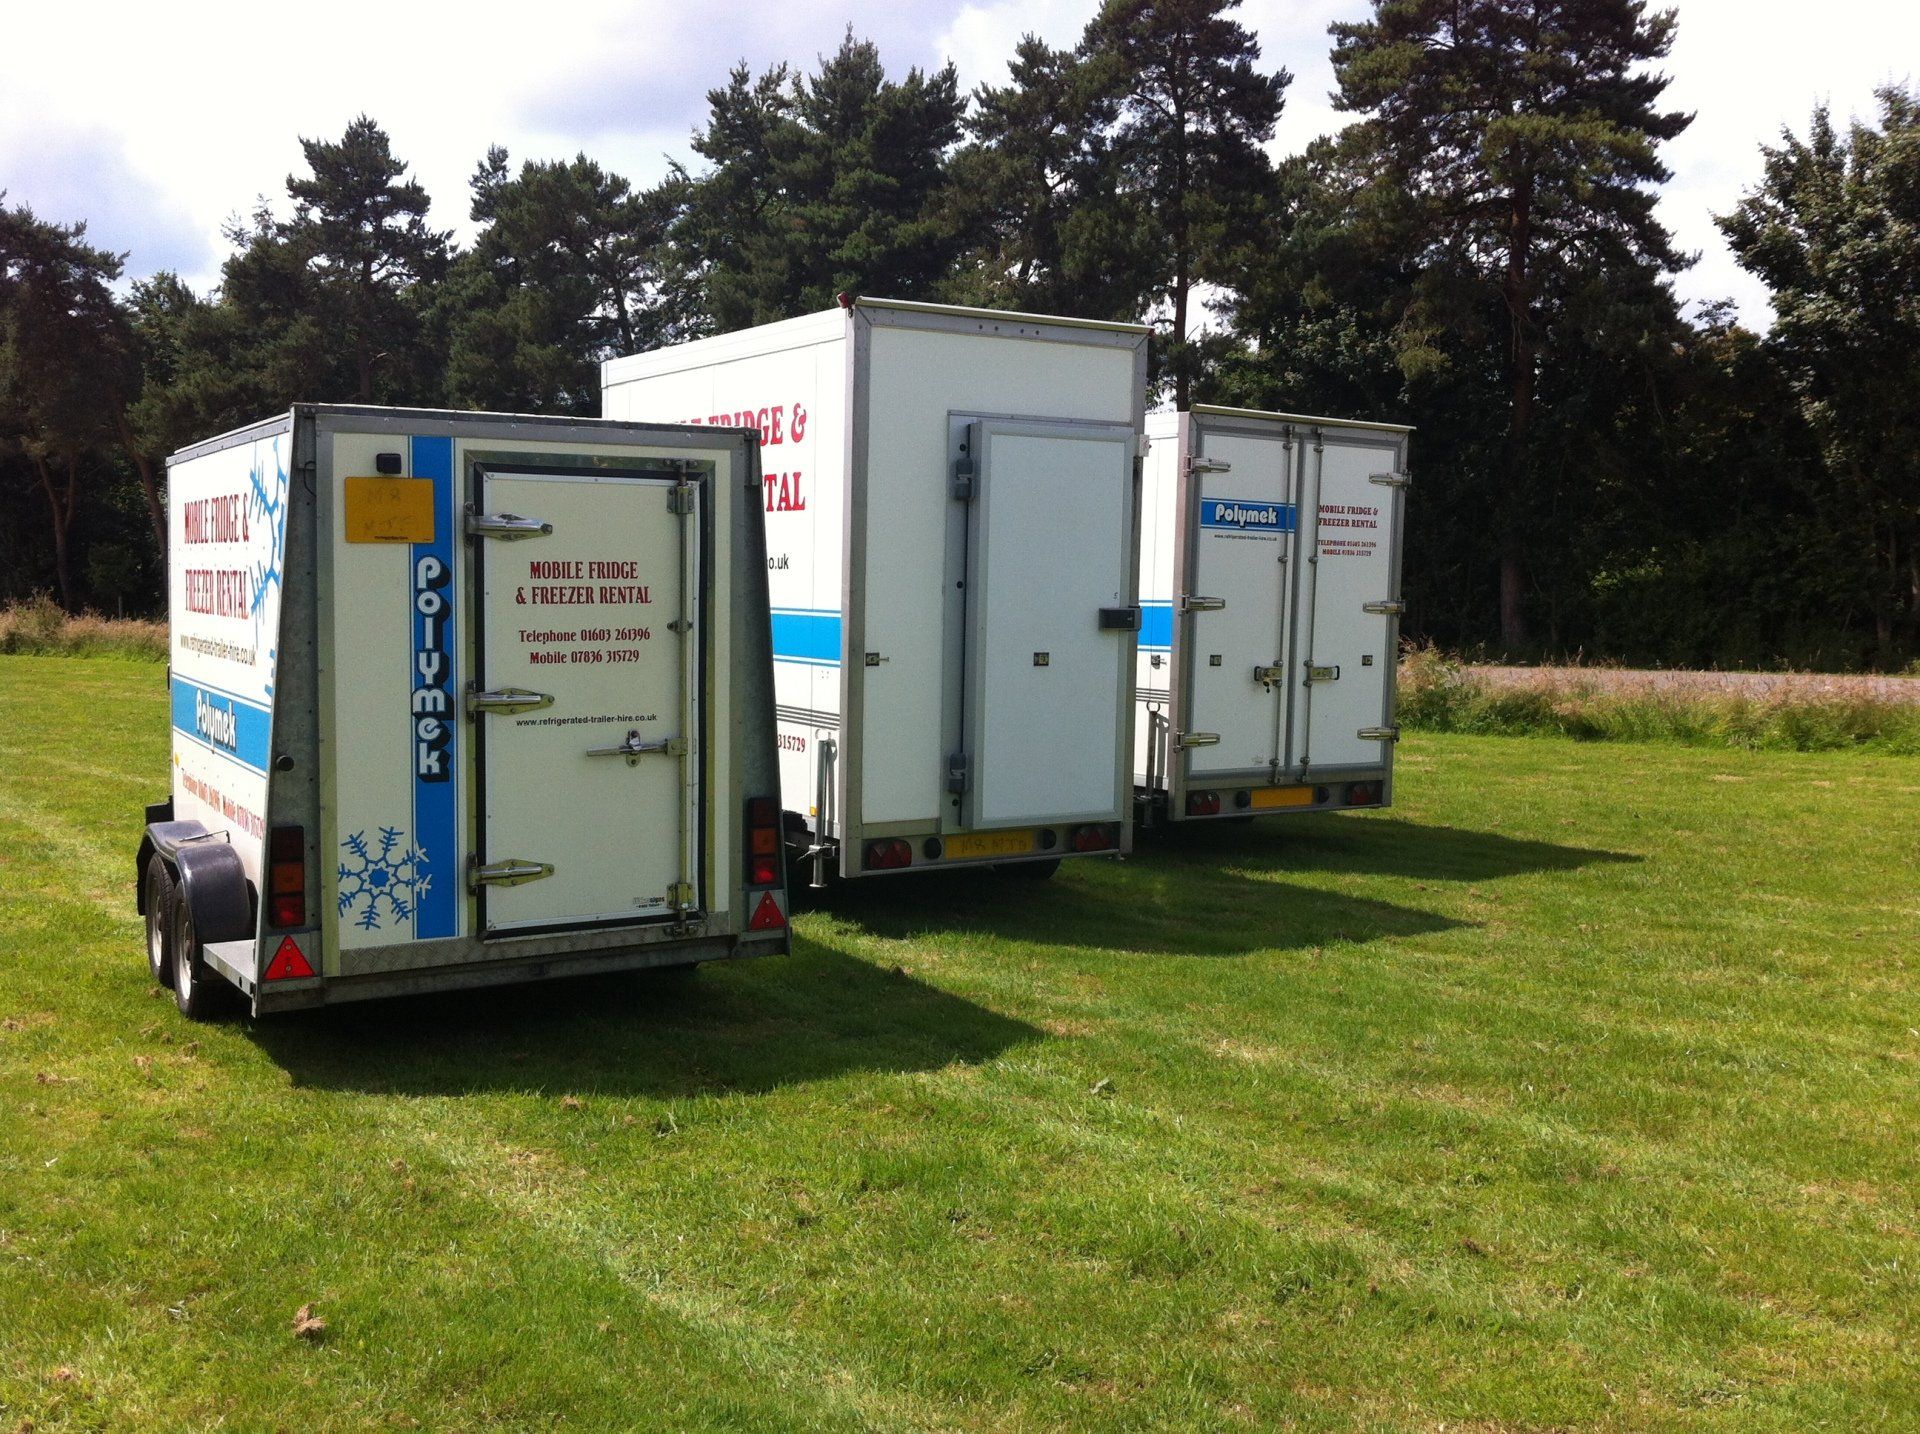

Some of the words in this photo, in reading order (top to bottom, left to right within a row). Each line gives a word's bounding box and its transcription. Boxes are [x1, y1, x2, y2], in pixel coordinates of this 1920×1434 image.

[791, 402, 807, 443] &
[762, 472, 806, 512] TAL
[185, 499, 209, 544] MOBILE
[211, 494, 240, 543] FRIDGE
[242, 493, 249, 542] &
[1215, 503, 1277, 527] Polymek
[1318, 505, 1345, 514] MOBILE
[1346, 506, 1372, 515] FRIDGE
[1373, 507, 1379, 516] &
[1318, 518, 1349, 527] FREEZER
[1351, 519, 1377, 529] RENTAL
[530, 561, 583, 579] MOBILE
[588, 561, 639, 579] FRIDGE
[186, 569, 214, 615] FREEZER
[216, 570, 249, 620] RENTAL
[515, 586, 527, 604] &
[532, 586, 595, 605] FREEZER
[600, 586, 652, 604] RENTAL
[519, 630, 577, 645] Telephone
[581, 627, 611, 642] 01603
[615, 627, 650, 641] 261396
[530, 651, 567, 664] Mobile
[571, 650, 603, 664] 07836
[606, 649, 640, 663] 315729
[411, 556, 452, 780] Polymek
[196, 688, 237, 752] Polymek
[516, 713, 657, 727] www.refrigerated-trailer-hire.co.uk
